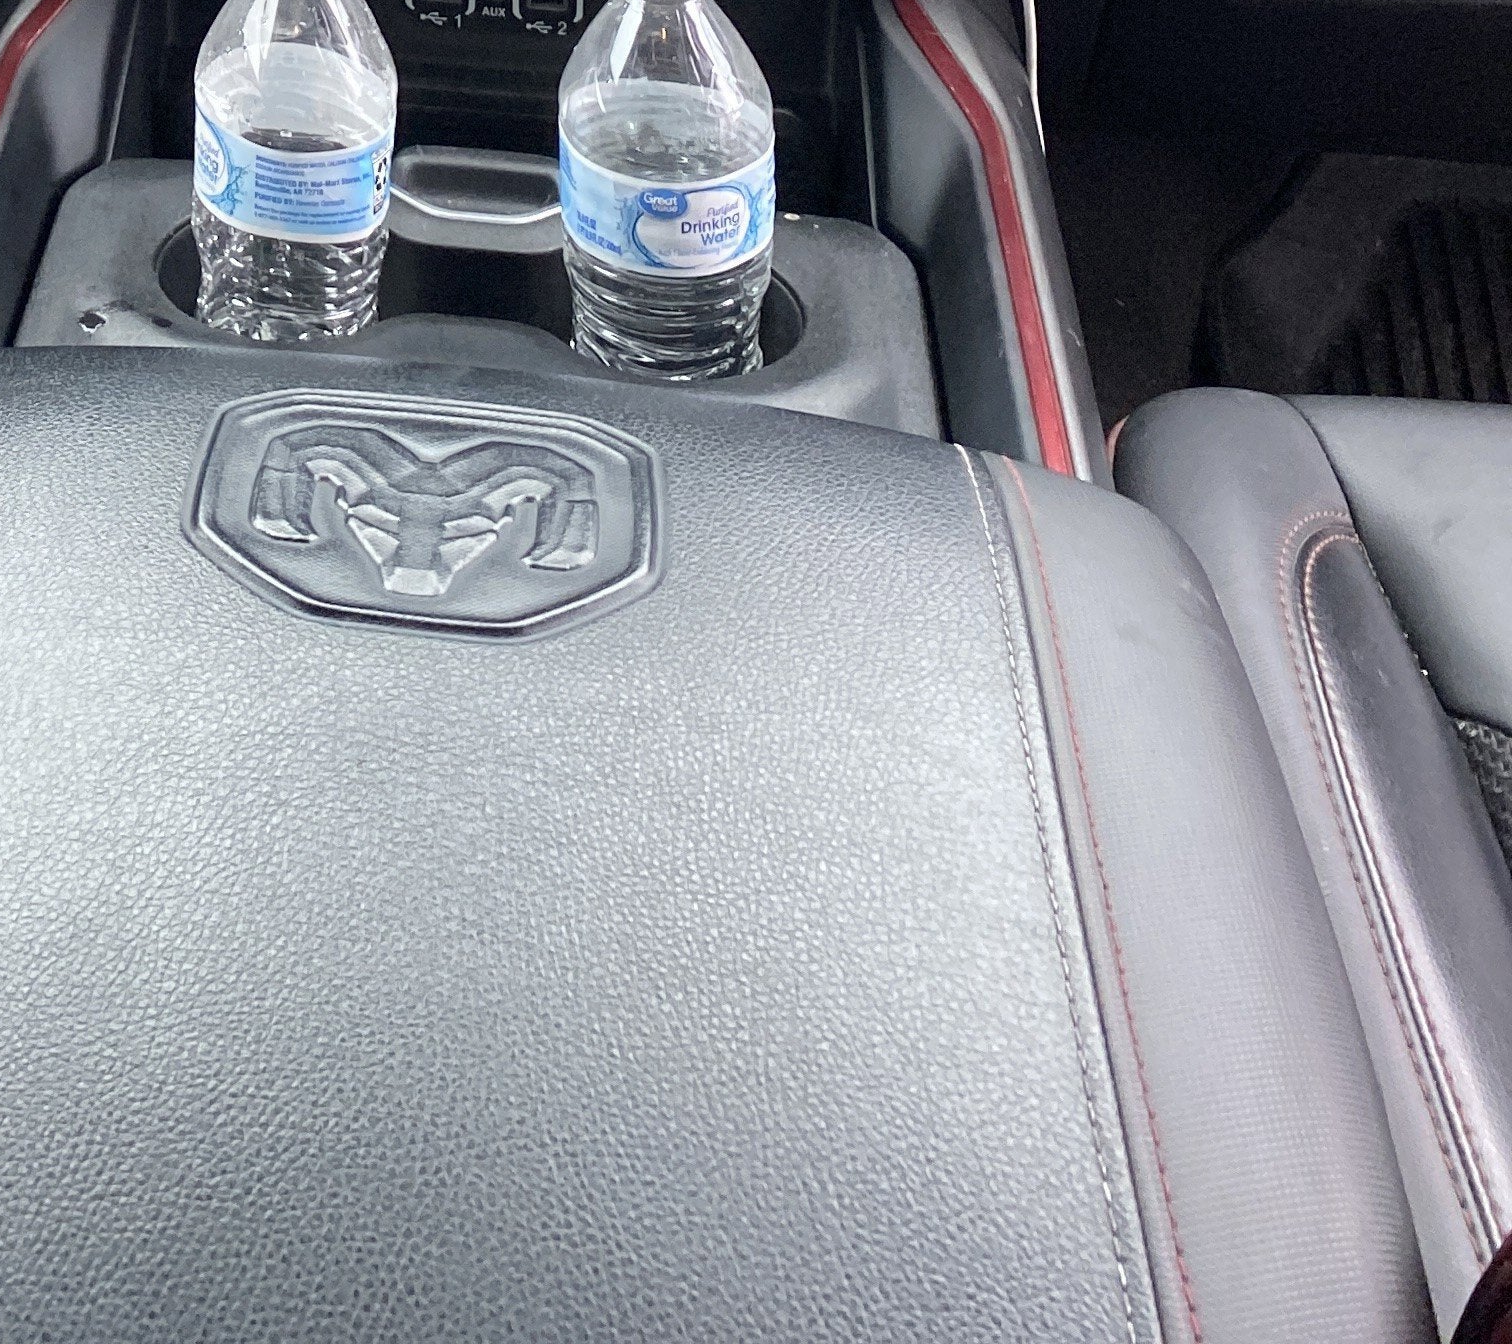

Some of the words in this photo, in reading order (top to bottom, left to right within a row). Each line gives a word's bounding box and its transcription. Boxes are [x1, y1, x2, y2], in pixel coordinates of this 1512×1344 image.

[482, 6, 506, 17] AUX
[454, 14, 462, 29] 1
[557, 21, 568, 36] 2
[644, 192, 678, 206] Great
[707, 198, 739, 217] Purified
[681, 212, 740, 234] Drinking
[701, 225, 740, 246] Water
